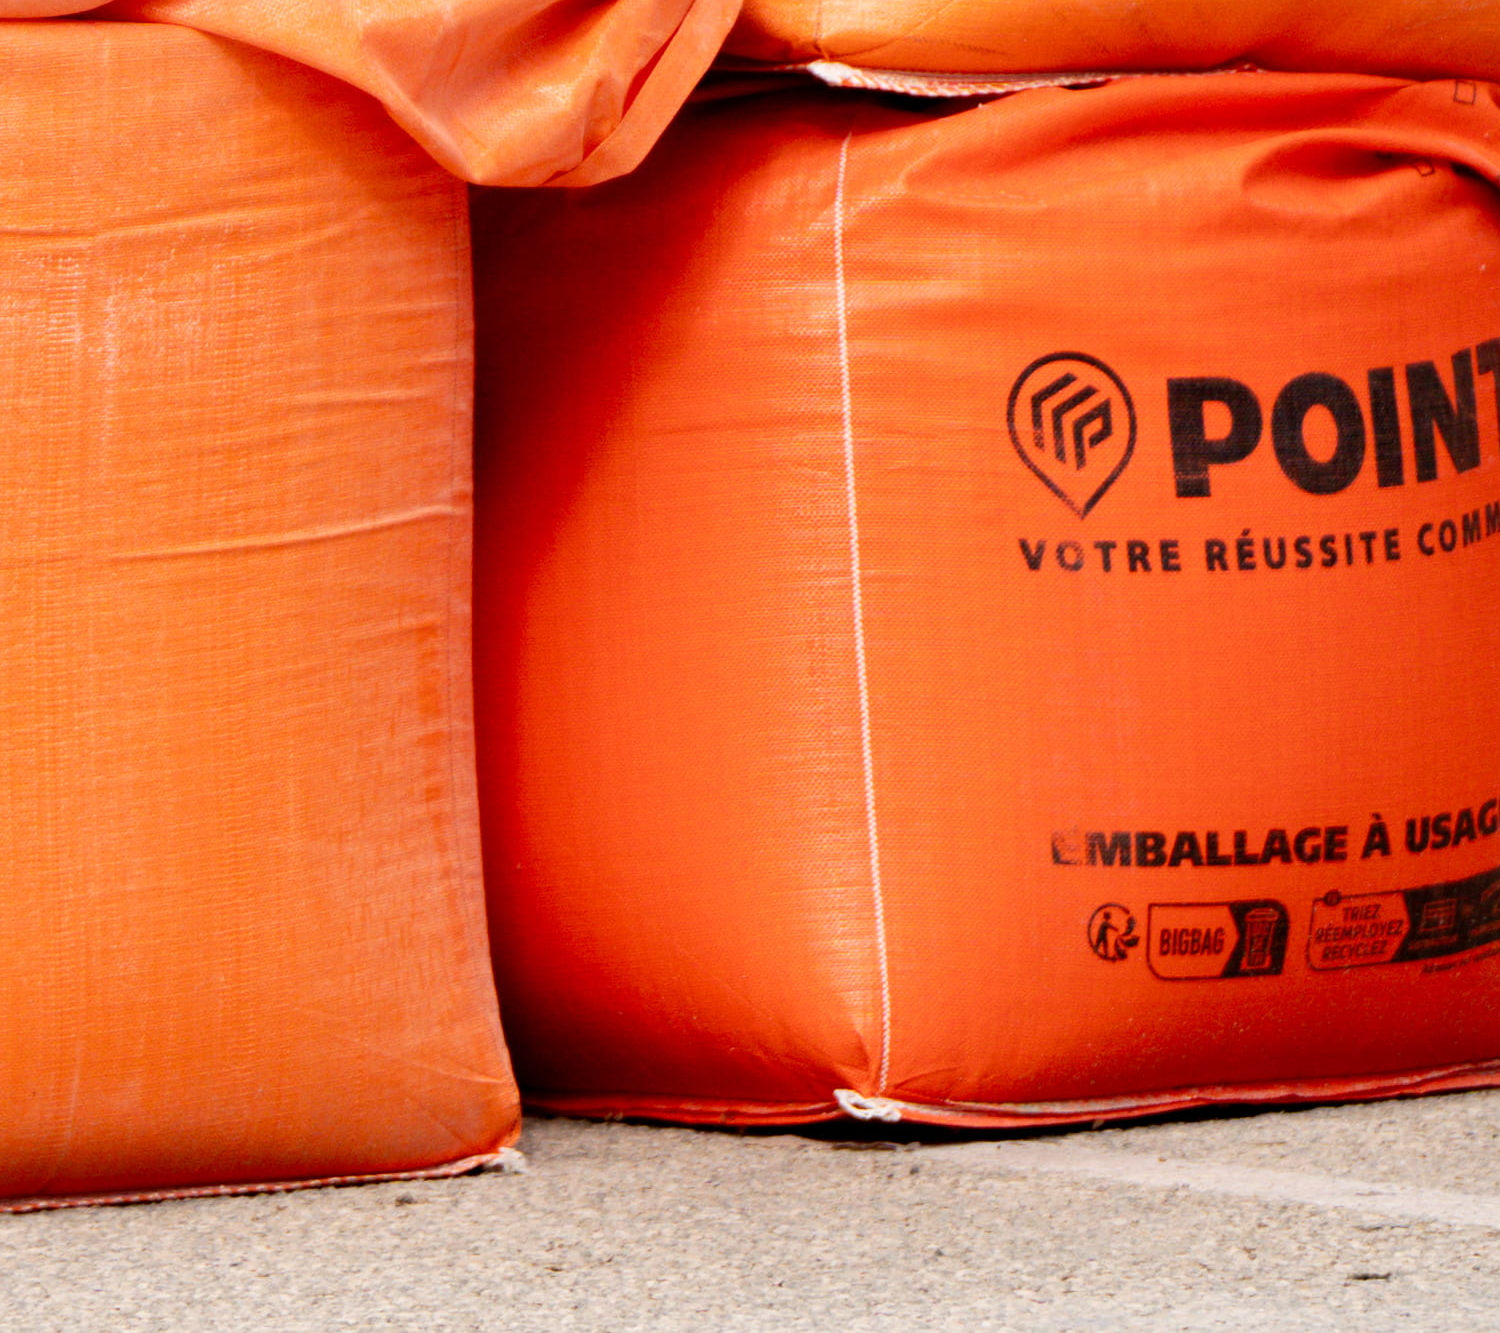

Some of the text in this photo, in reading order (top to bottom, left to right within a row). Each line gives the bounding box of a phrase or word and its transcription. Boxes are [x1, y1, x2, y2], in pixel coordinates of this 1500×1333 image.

[1018, 537, 1182, 575] VOTRE
[1205, 529, 1402, 576] RÉUSSITE
[1051, 821, 1349, 868] EMBALLAGE
[1361, 811, 1392, 860] À
[1341, 903, 1382, 922] TRIEZ
[1158, 926, 1226, 957] BIGBAG
